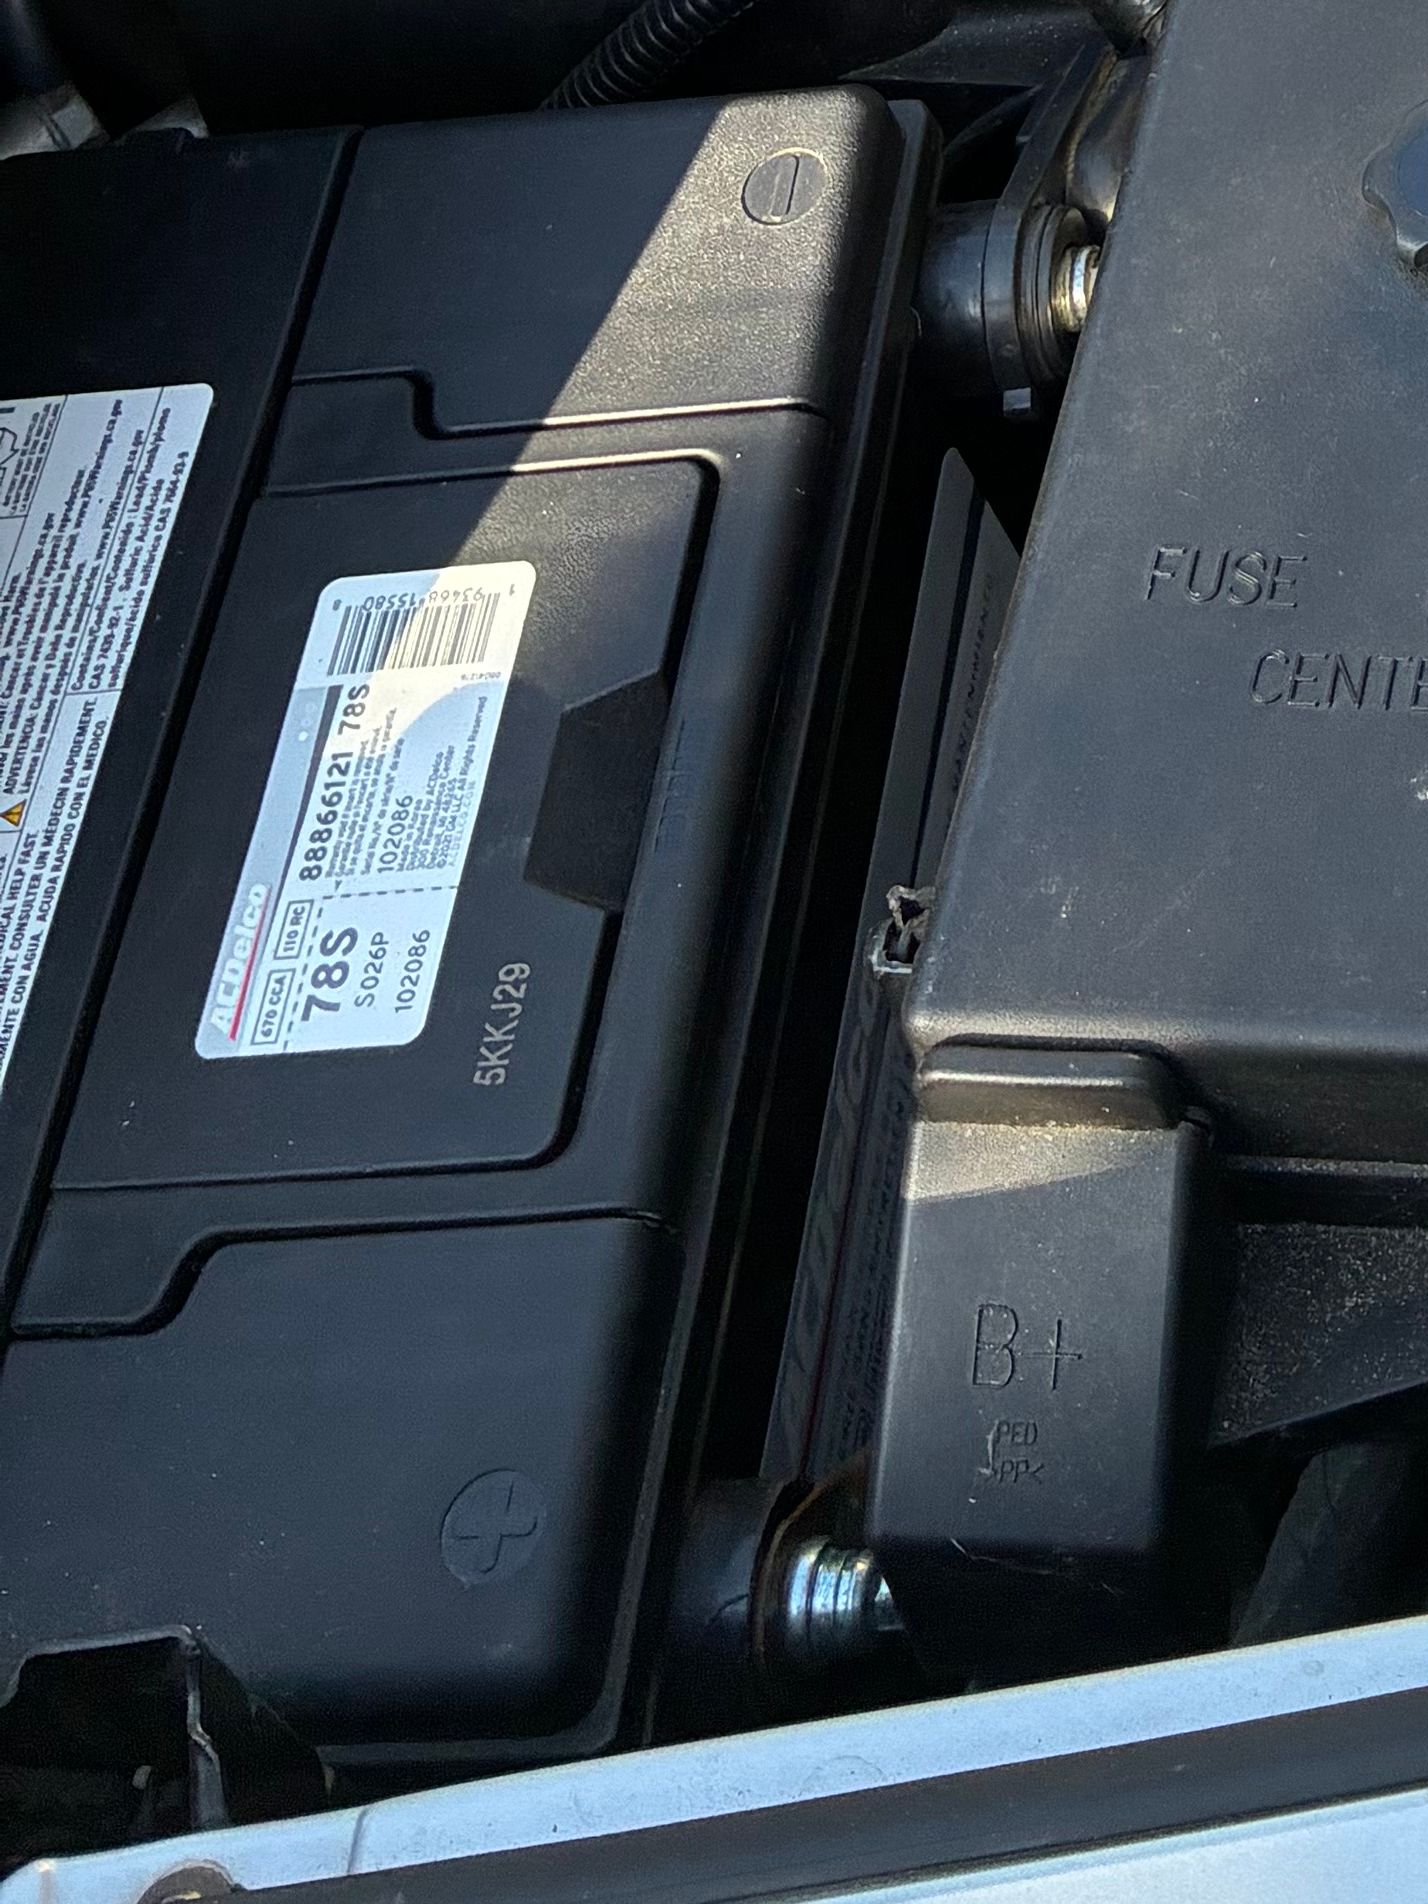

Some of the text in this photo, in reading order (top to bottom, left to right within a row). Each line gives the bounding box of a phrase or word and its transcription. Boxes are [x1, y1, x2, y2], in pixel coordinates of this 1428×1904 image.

[1144, 543, 1308, 608] FUSE
[467, 695, 489, 743] Reserved
[299, 751, 354, 881] 88866121
[337, 683, 371, 736] 78S
[377, 795, 413, 874] 102086
[10, 867, 26, 902] HELP
[11, 972, 28, 1004] CON
[36, 872, 61, 923] ACUDA
[50, 821, 75, 872] RAPIDO
[66, 791, 85, 822] CON
[80, 771, 92, 790] EL
[12, 878, 42, 953] CONSULTER
[38, 850, 51, 873] UN
[209, 881, 271, 1038] ACDelco
[260, 905, 307, 1038] 670 CCA 110 RC
[301, 925, 360, 1023] 78S
[353, 930, 390, 1010] S026P
[393, 928, 432, 1014] 102086
[472, 961, 532, 1086] 5KKJ29
[971, 1302, 1083, 1392] B+
